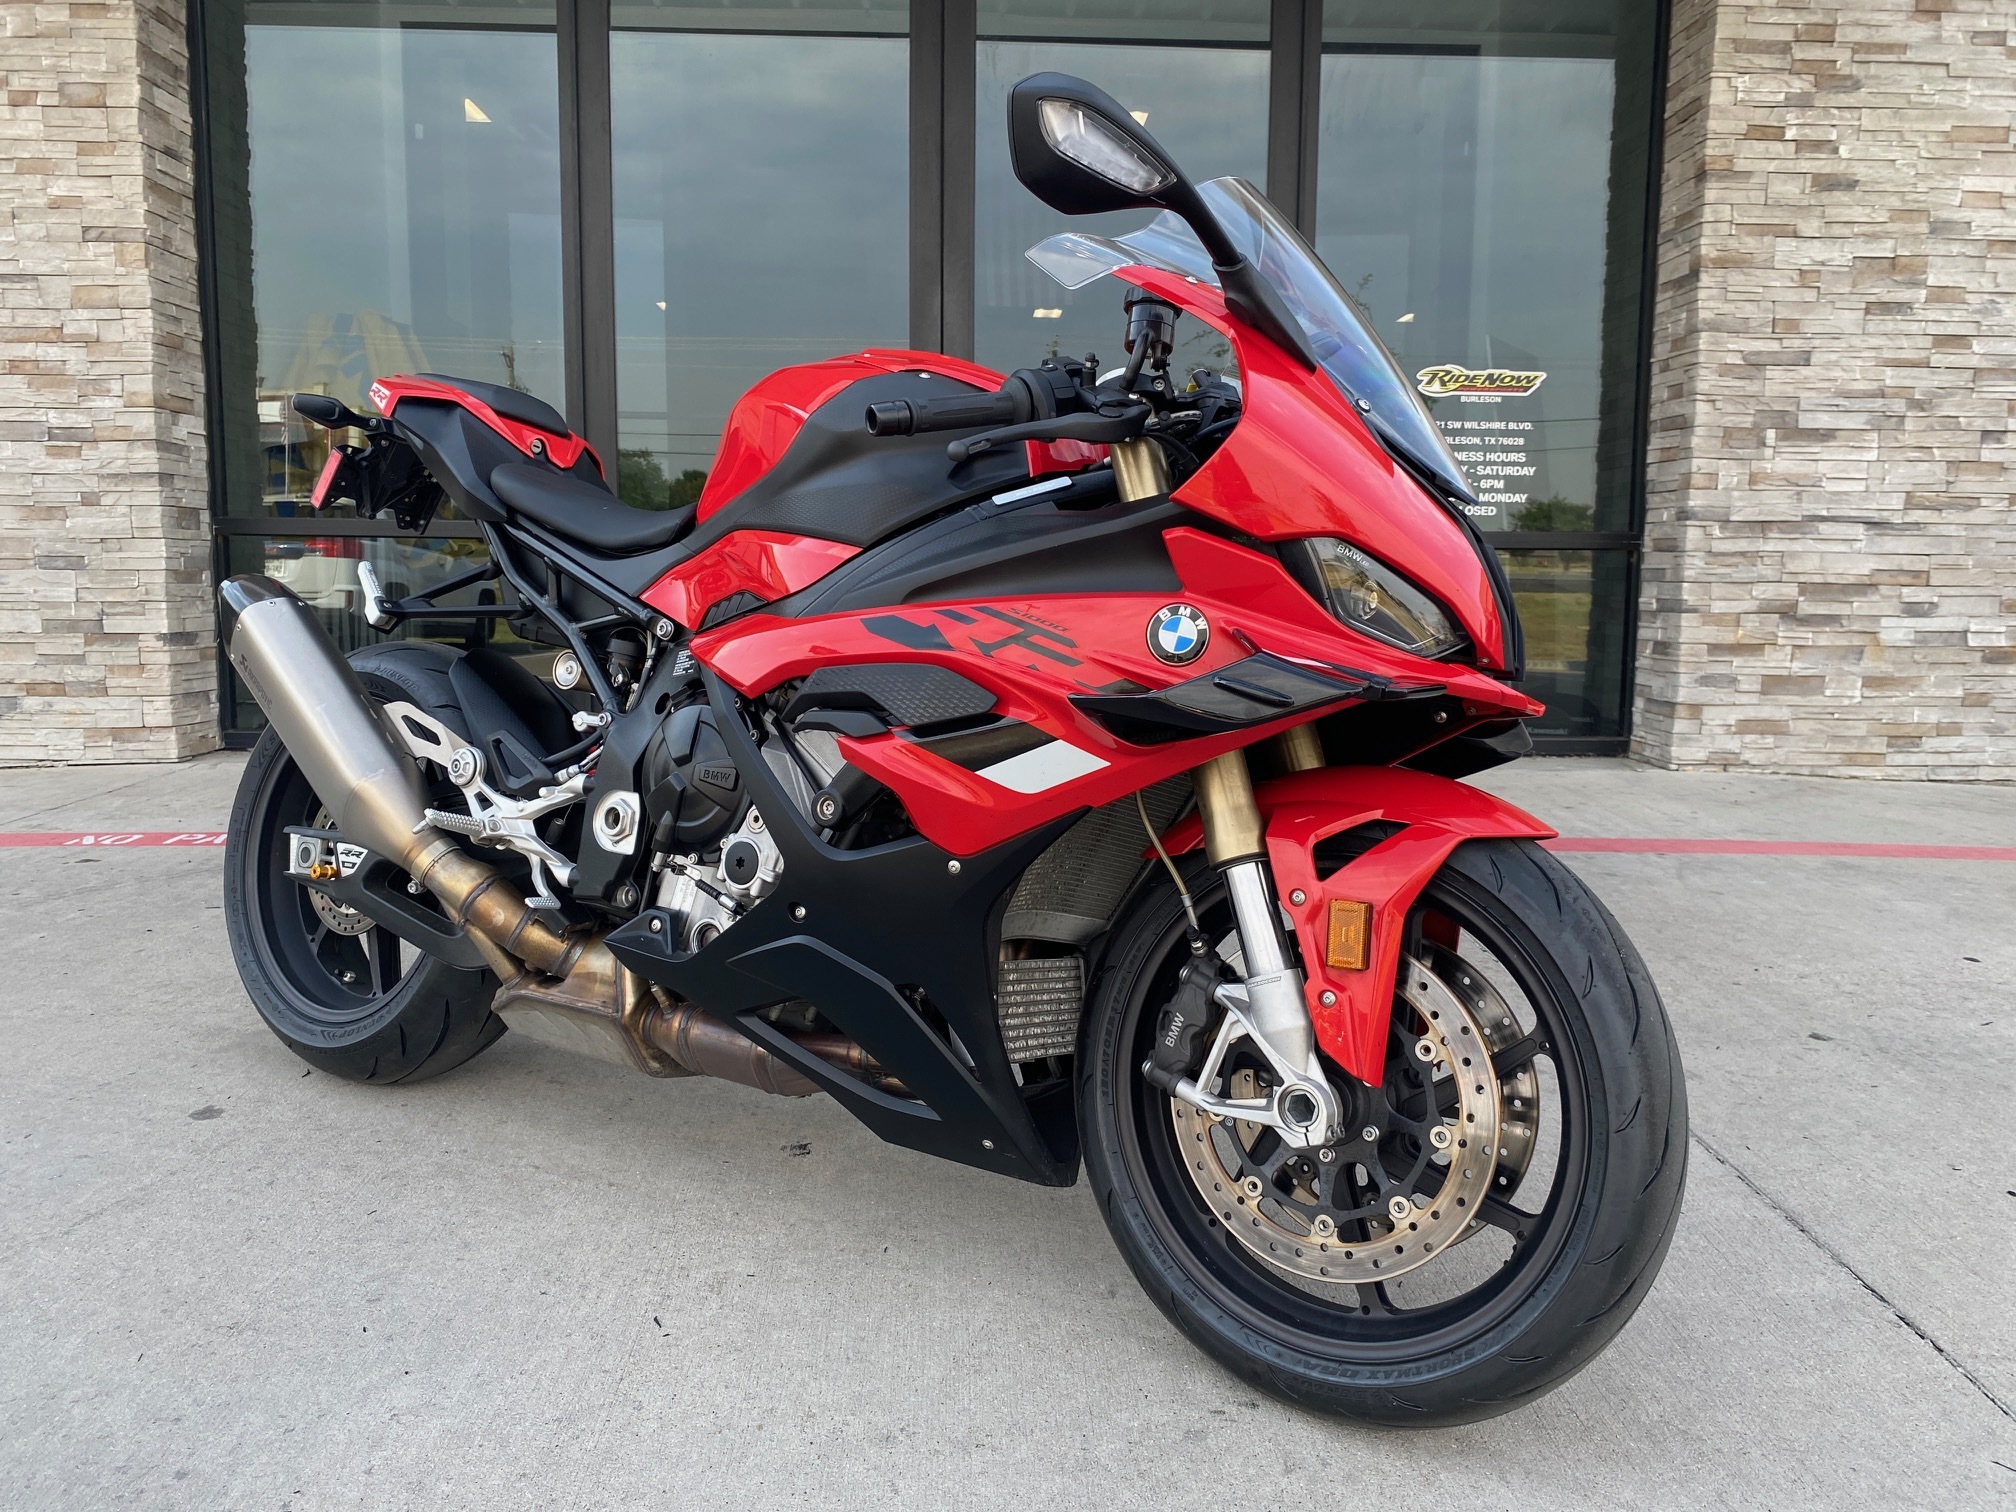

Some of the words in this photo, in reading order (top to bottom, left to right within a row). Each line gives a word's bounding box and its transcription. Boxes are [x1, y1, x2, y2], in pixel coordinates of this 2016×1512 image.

[1447, 421, 1462, 429] SW
[1463, 421, 1507, 430] WILSHIRE
[1444, 436, 1483, 446] RLESON,
[1484, 437, 1496, 445] TX
[1497, 437, 1525, 446] 76028
[1453, 451, 1485, 462] NESS
[1486, 452, 1527, 463] HOURS
[1476, 465, 1537, 476] SATURDAY
[1480, 479, 1504, 489] 6PM
[1478, 492, 1528, 503] MONDAY
[1337, 544, 1362, 562] BMW
[703, 769, 731, 782] BMW
[64, 834, 144, 846] NO
[1165, 1012, 1184, 1048] BMW
